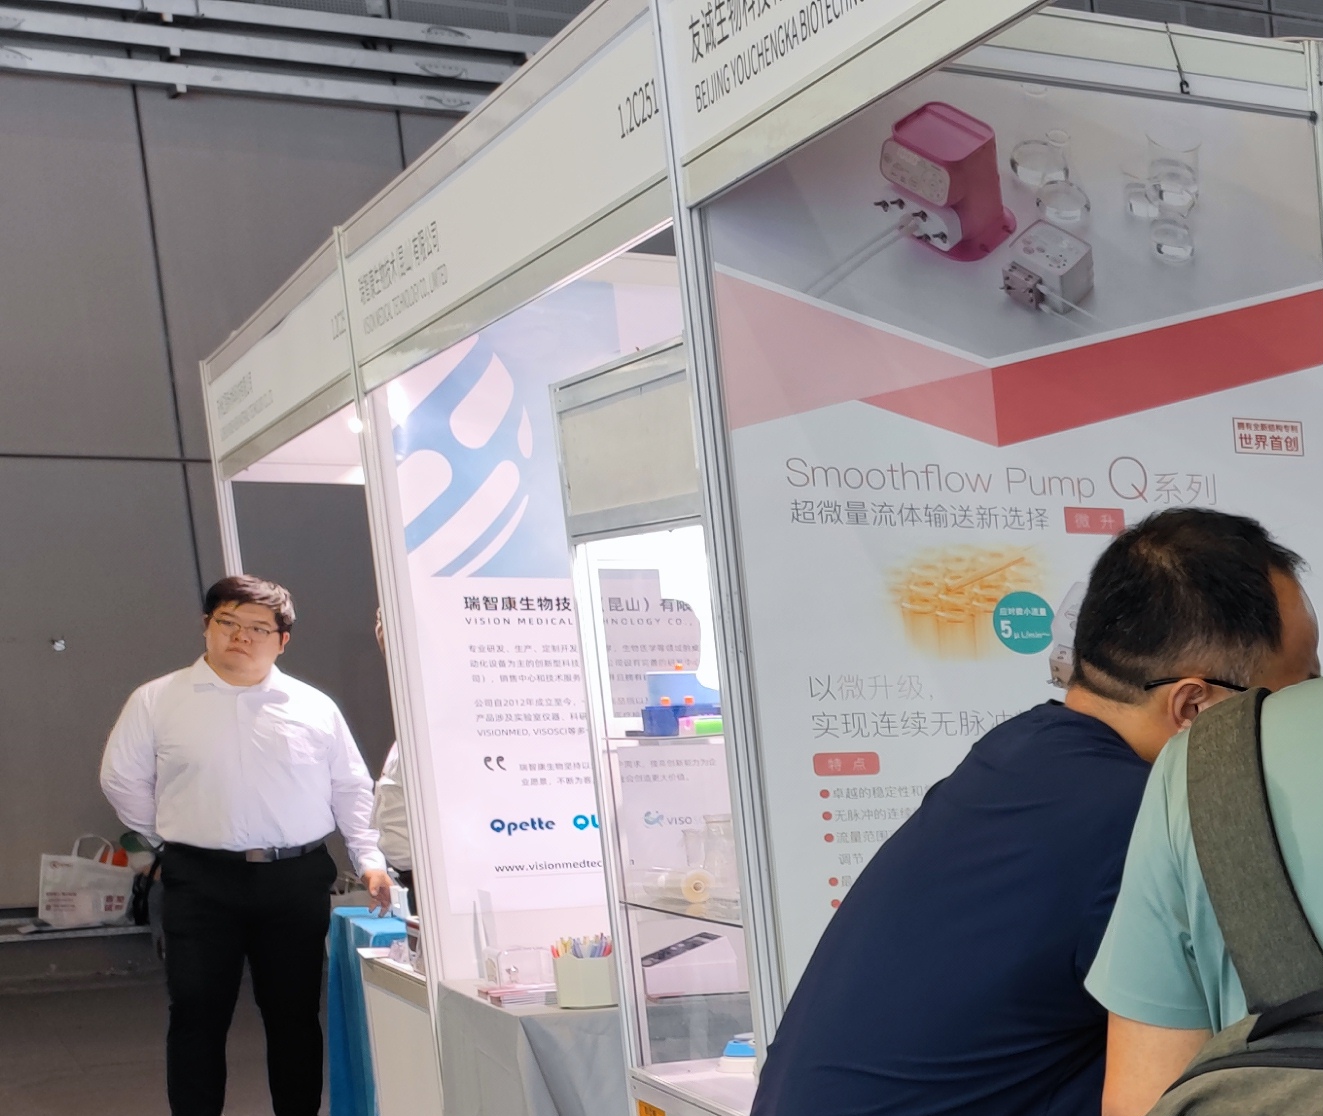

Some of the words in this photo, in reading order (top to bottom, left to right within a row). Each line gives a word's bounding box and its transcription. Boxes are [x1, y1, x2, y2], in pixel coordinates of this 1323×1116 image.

[688, 0, 782, 63] 友诚生物
[694, 63, 731, 113] BEIJING
[730, 15, 800, 88] YOUCHENGKA
[800, 0, 864, 42] BIOTEC
[618, 78, 659, 138] 1.2C251
[1239, 433, 1299, 452] 世界首创
[786, 457, 993, 494] Smoothflow
[1006, 467, 1095, 503] Pump
[790, 499, 1050, 532] 超微量流体输送新选择
[465, 617, 511, 625] VISION
[517, 616, 574, 626] MEDICAL
[811, 710, 1024, 739] 实现连续无脉冲
[827, 758, 867, 772] 特点
[490, 816, 556, 836] Qpette
[834, 806, 916, 822] 无脉冲的连续
[837, 852, 864, 866] 调节
